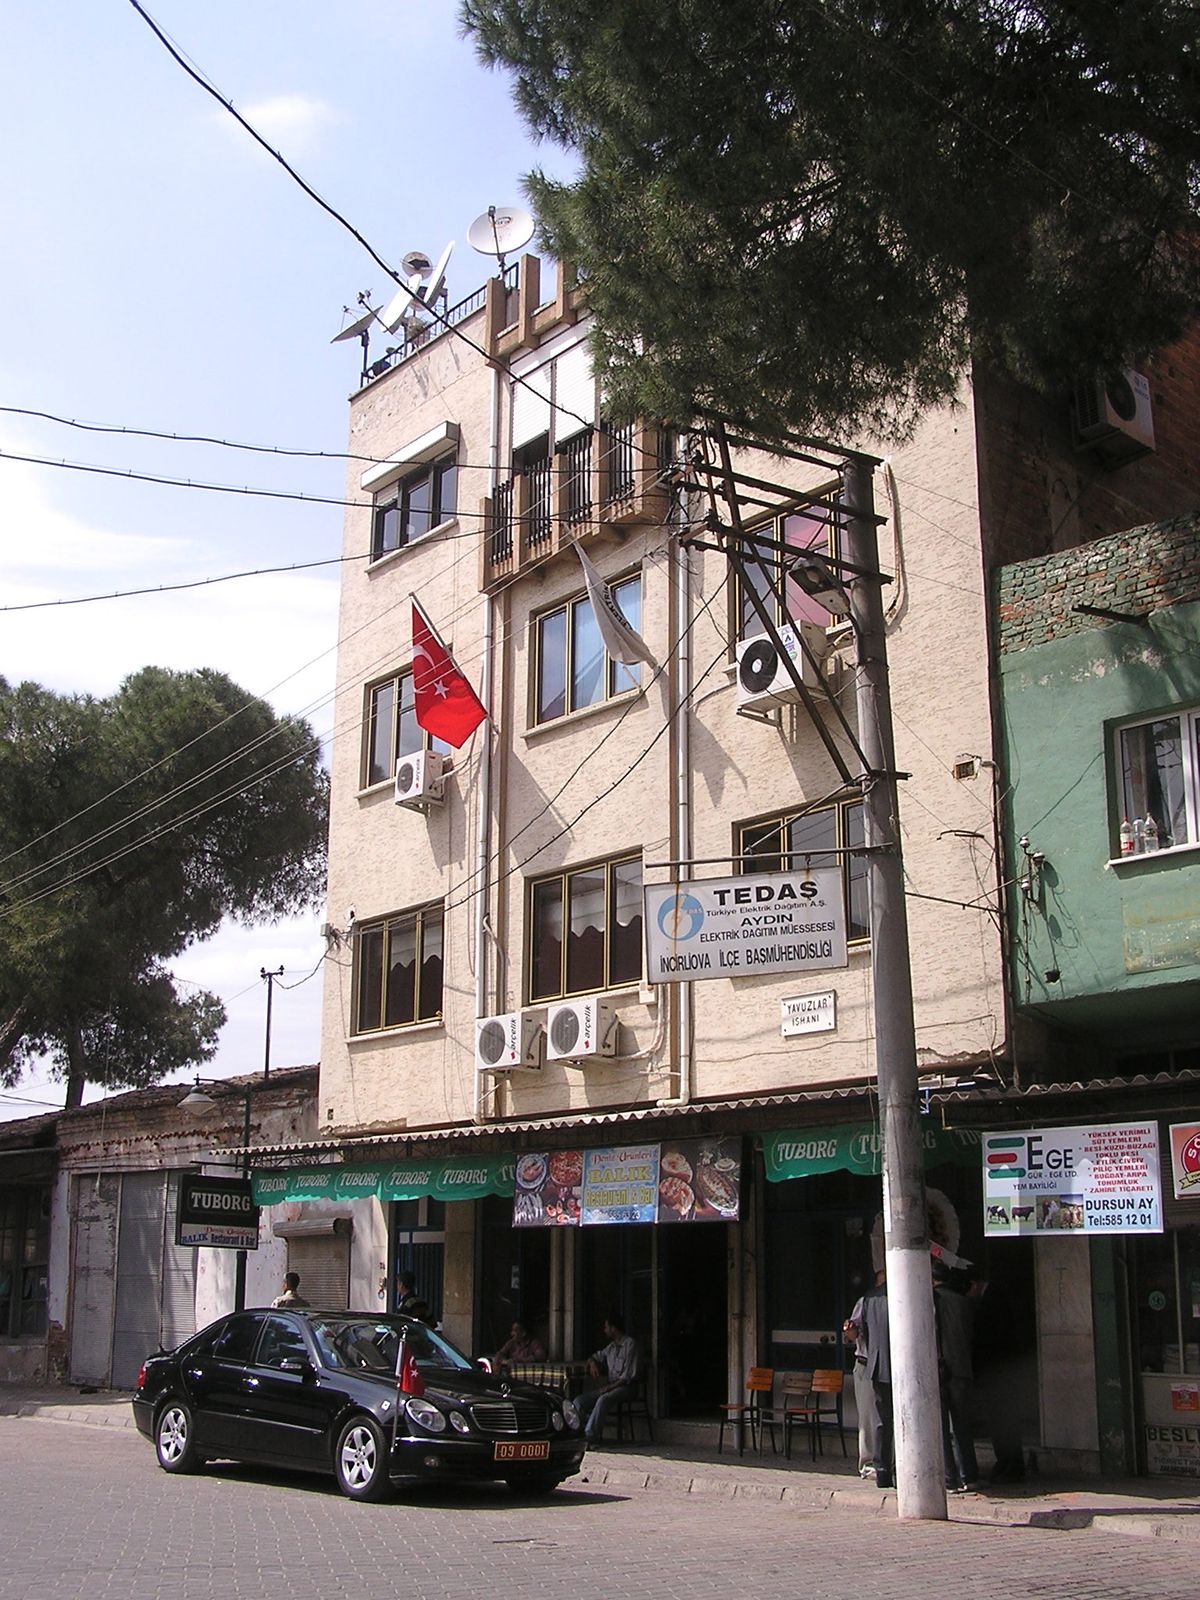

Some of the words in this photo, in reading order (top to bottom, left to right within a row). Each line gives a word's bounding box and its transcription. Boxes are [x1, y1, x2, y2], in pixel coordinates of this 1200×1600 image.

[713, 880, 819, 906] TEDAŞ
[706, 908, 737, 917] Türkiye
[740, 904, 772, 914] Elektrik
[774, 902, 808, 912] Dağıtım
[740, 913, 793, 927] AYDIN
[700, 928, 740, 943] ELEKTRİK
[742, 926, 778, 939] DAĞITIM
[780, 920, 836, 935] MÜESSESESİ
[660, 952, 712, 973] İNCİRLİOVA
[719, 949, 740, 969] İLÇE
[787, 998, 828, 1015] YAVUZLAR
[1119, 1128, 1151, 1136] VERİMLİ
[777, 1139, 838, 1162] TUBORG
[1027, 1136, 1074, 1170] EGE
[296, 1174, 332, 1188] TUBORG
[340, 1172, 380, 1187] TUBORG
[389, 1171, 432, 1186] TUBORG
[442, 1168, 488, 1185] TUBORG
[589, 1165, 652, 1183] BALIK
[1027, 1171, 1043, 1179] GÜR
[1049, 1171, 1063, 1179] EGE
[191, 1191, 251, 1211] TUBORG
[586, 1185, 629, 1207] Restaurant
[639, 1185, 654, 1205] Bar
[1085, 1198, 1135, 1211] DURSUN
[1138, 1198, 1154, 1210] AY
[1087, 1214, 1123, 1226] Tel:585
[1126, 1214, 1138, 1225] 12
[1140, 1213, 1152, 1225] 01
[500, 1445, 515, 1457] 09
[520, 1444, 545, 1457] 0001
